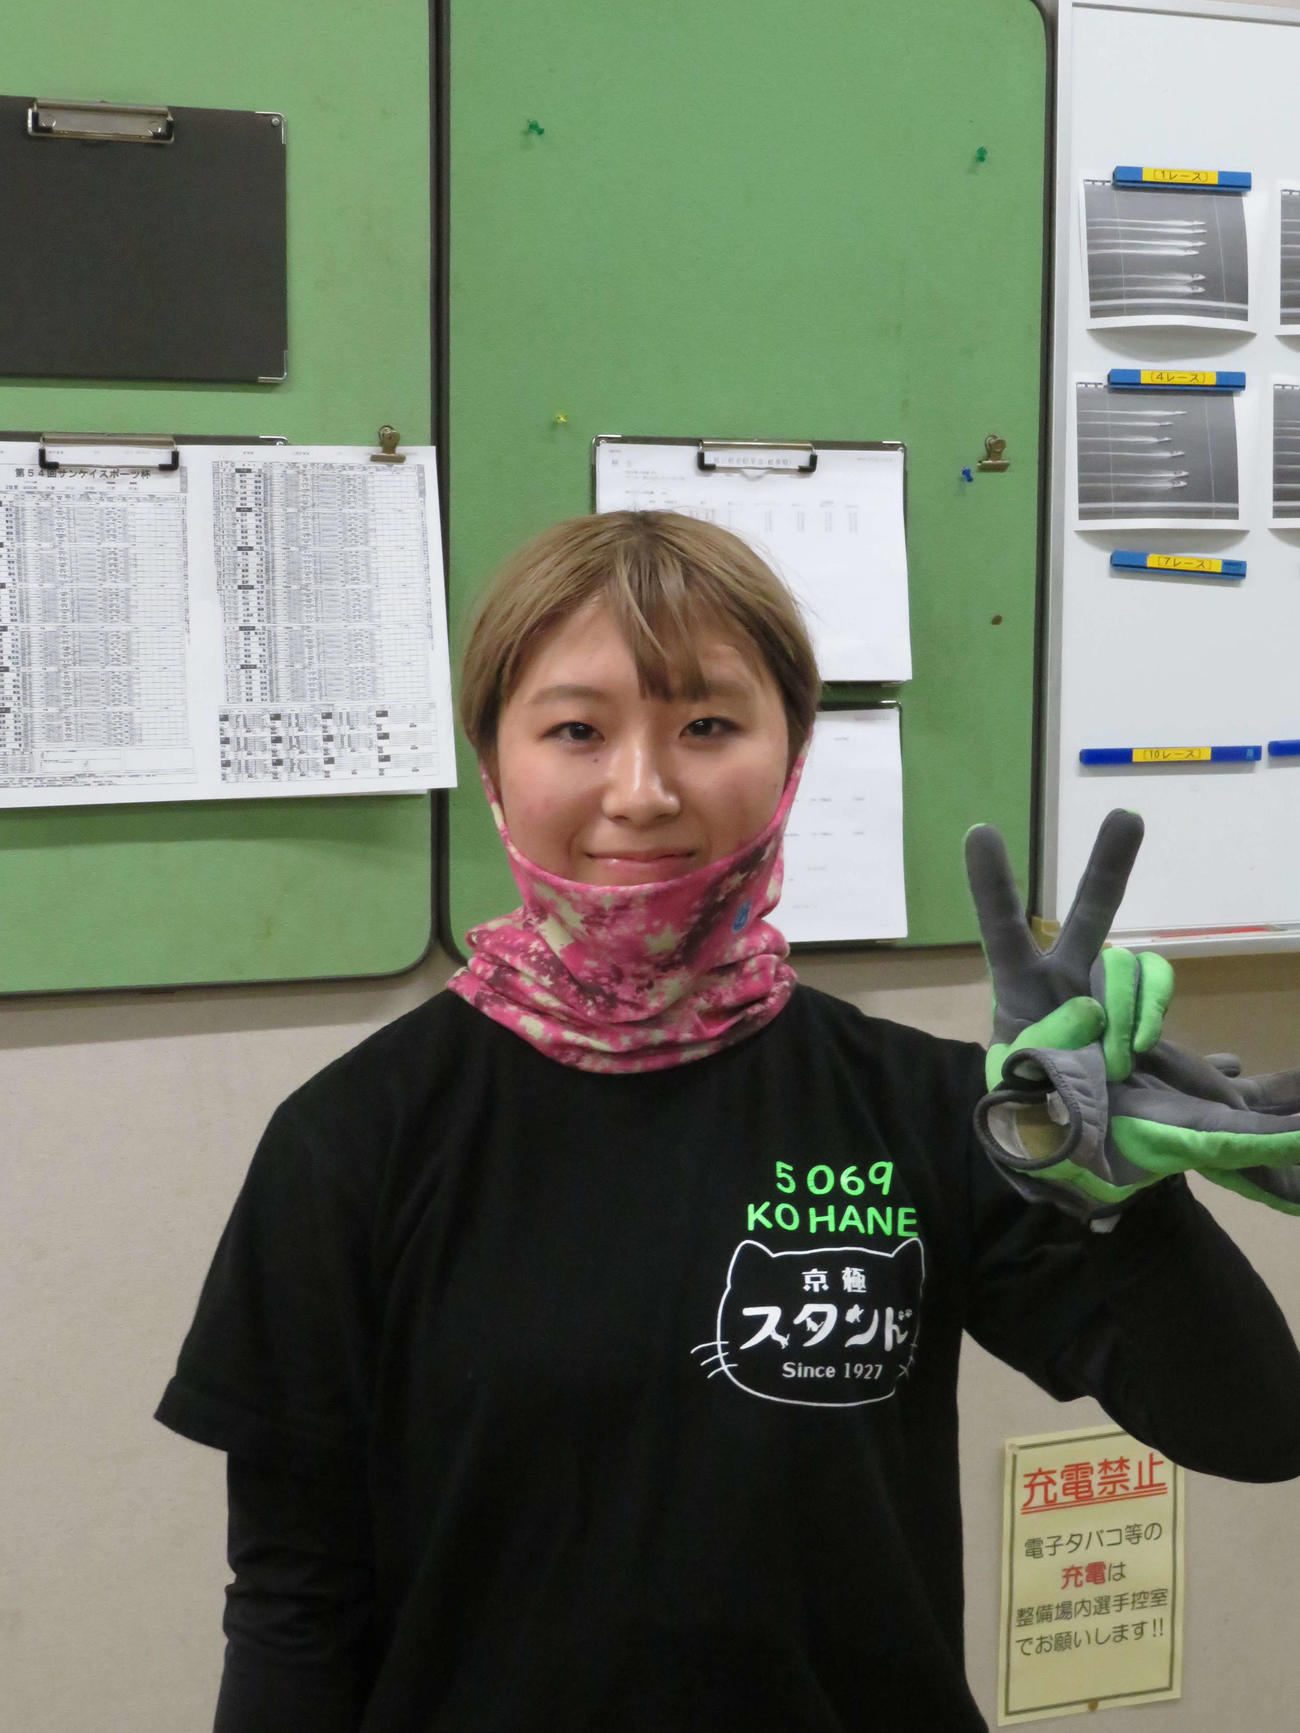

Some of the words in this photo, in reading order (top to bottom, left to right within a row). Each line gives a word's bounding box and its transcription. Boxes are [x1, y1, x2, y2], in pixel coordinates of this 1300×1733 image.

[775, 1161, 894, 1196] 5069
[746, 1201, 919, 1237] KOHANE
[739, 1303, 913, 1352] スタンド
[782, 1362, 836, 1379] Since
[844, 1363, 883, 1380] 1927
[1021, 1452, 1167, 1508] 充電禁止
[1024, 1521, 1163, 1559] 電子タバコ等の
[1060, 1560, 1127, 1590] 充電は
[1015, 1588, 1169, 1628] 整備場内選手控室
